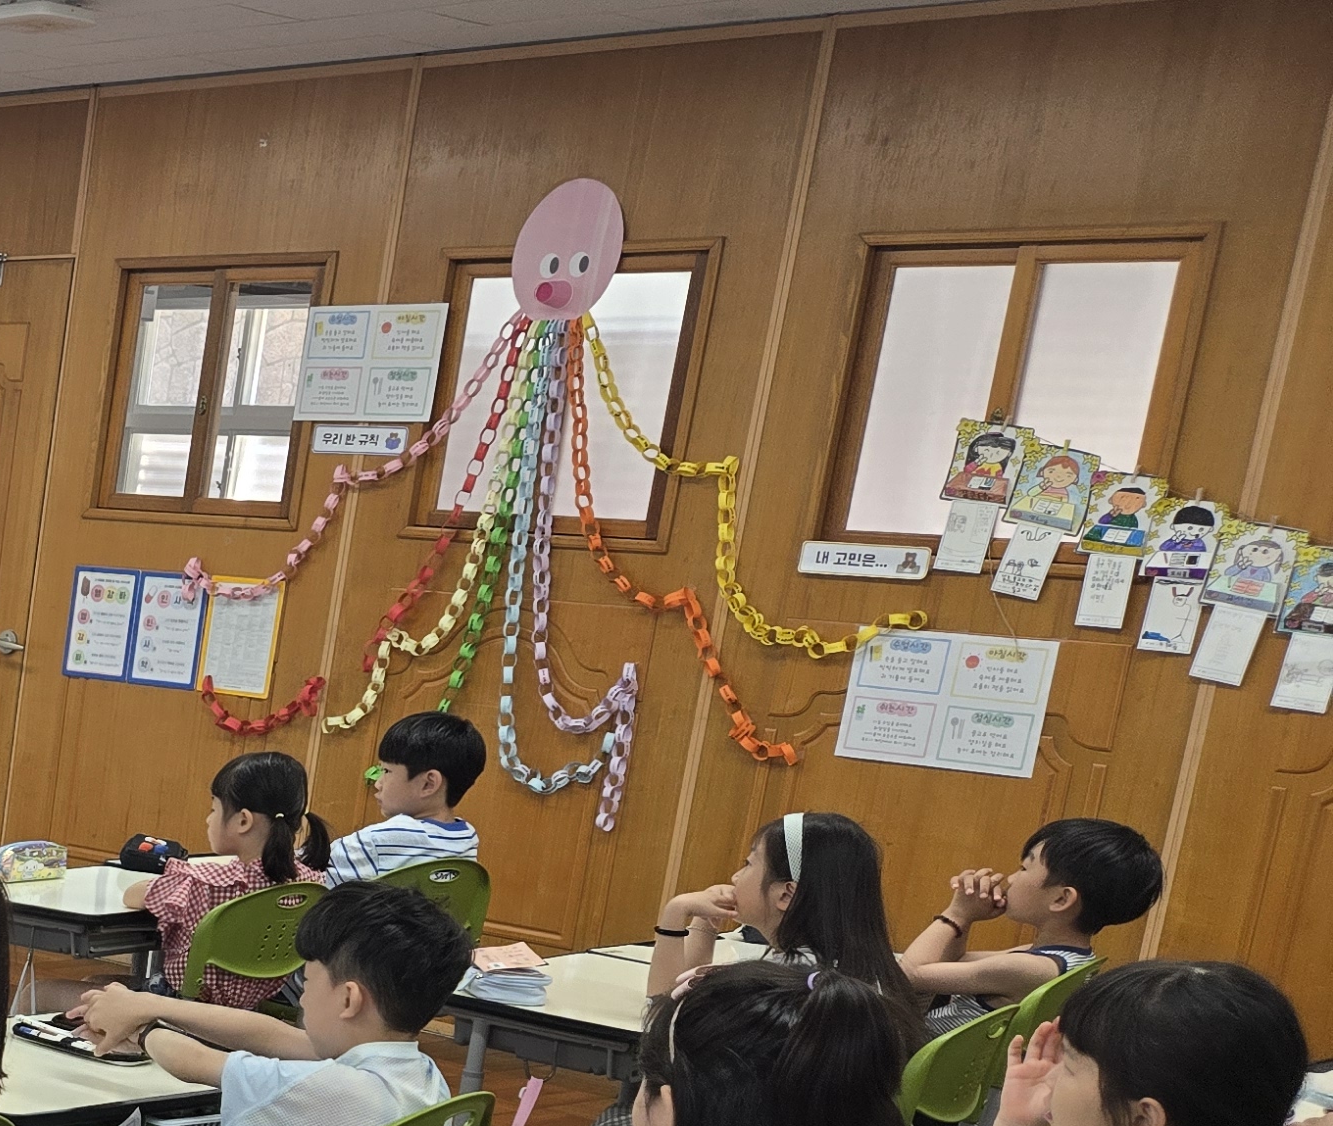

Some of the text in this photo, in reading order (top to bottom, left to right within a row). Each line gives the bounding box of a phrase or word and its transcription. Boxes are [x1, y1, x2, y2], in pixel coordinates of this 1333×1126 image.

[322, 432, 379, 446] 우리 반 규칙
[815, 551, 887, 568] 내 고민은...
[893, 640, 929, 652] 수업시간
[989, 649, 1028, 660] 아침시간
[975, 713, 1011, 725] 점심시간
